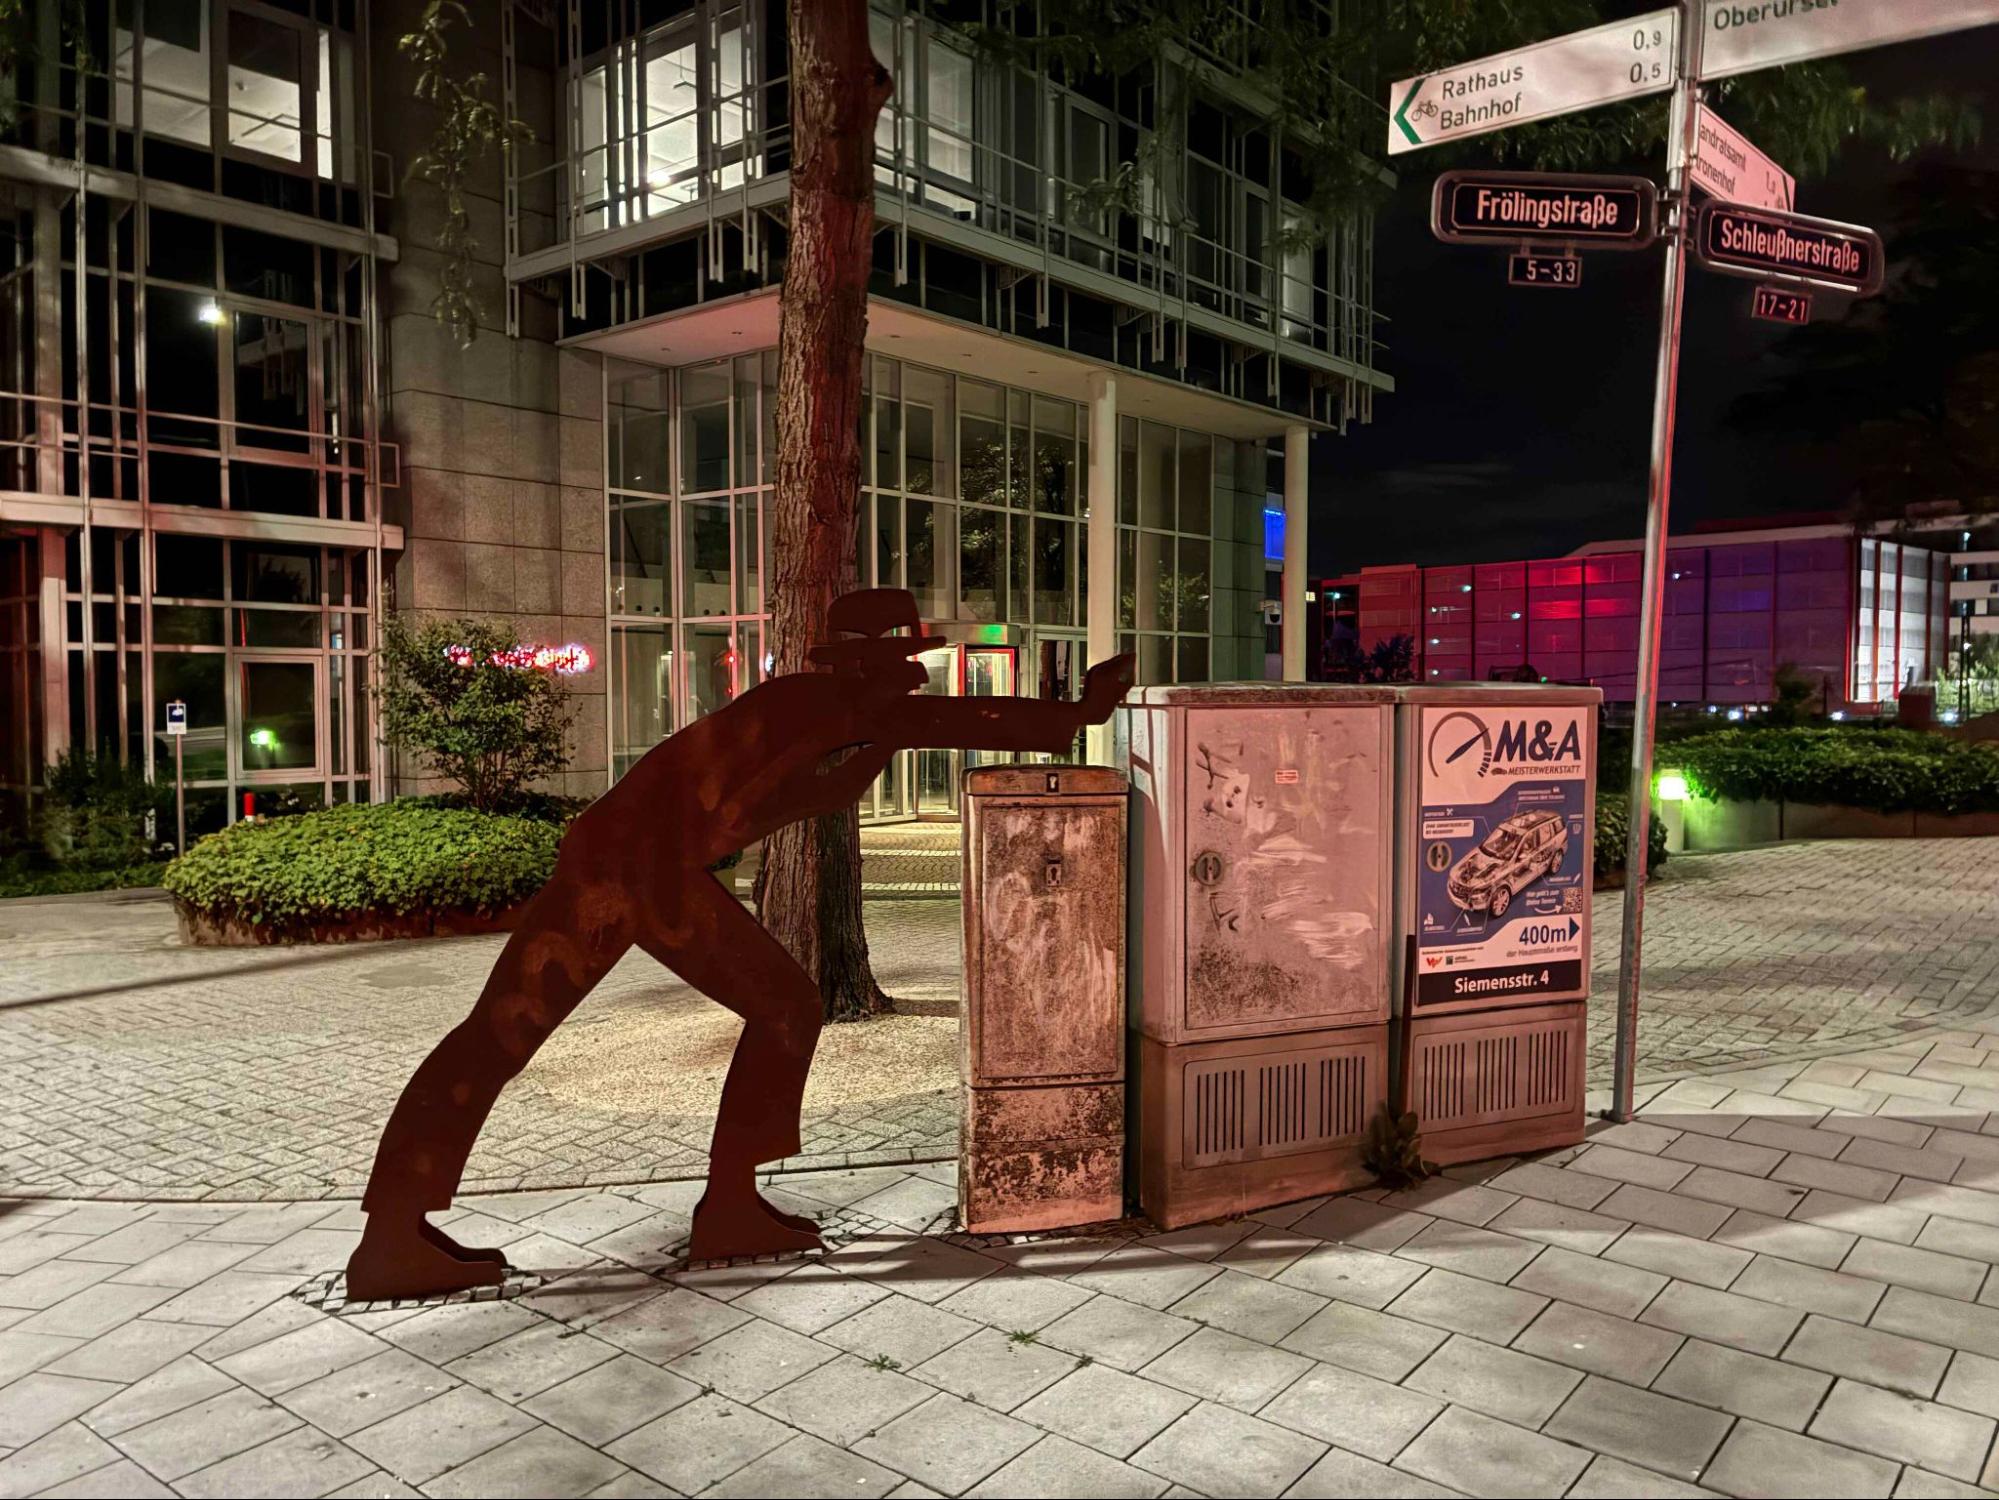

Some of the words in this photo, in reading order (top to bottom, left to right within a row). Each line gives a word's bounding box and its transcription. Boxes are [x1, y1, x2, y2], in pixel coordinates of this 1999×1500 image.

[1713, 0, 1838, 30] Oberurse
[1442, 66, 1524, 100] Rathaus
[1440, 92, 1522, 130] Bahnhof
[1700, 124, 1746, 172] andratsamt
[1696, 157, 1736, 196] ronenhof
[1477, 189, 1618, 229] Frölingstraße
[1721, 218, 1860, 274] Schleußnerstraße
[1526, 260, 1577, 282] 5-33
[1760, 293, 1807, 321] 17-21
[1493, 719, 1581, 762] M&A
[1508, 764, 1581, 776] MEISTERWERKSTATT
[1519, 924, 1567, 945] 400m
[1454, 973, 1538, 994] Siemensstr.
[1540, 969, 1550, 985] 4
